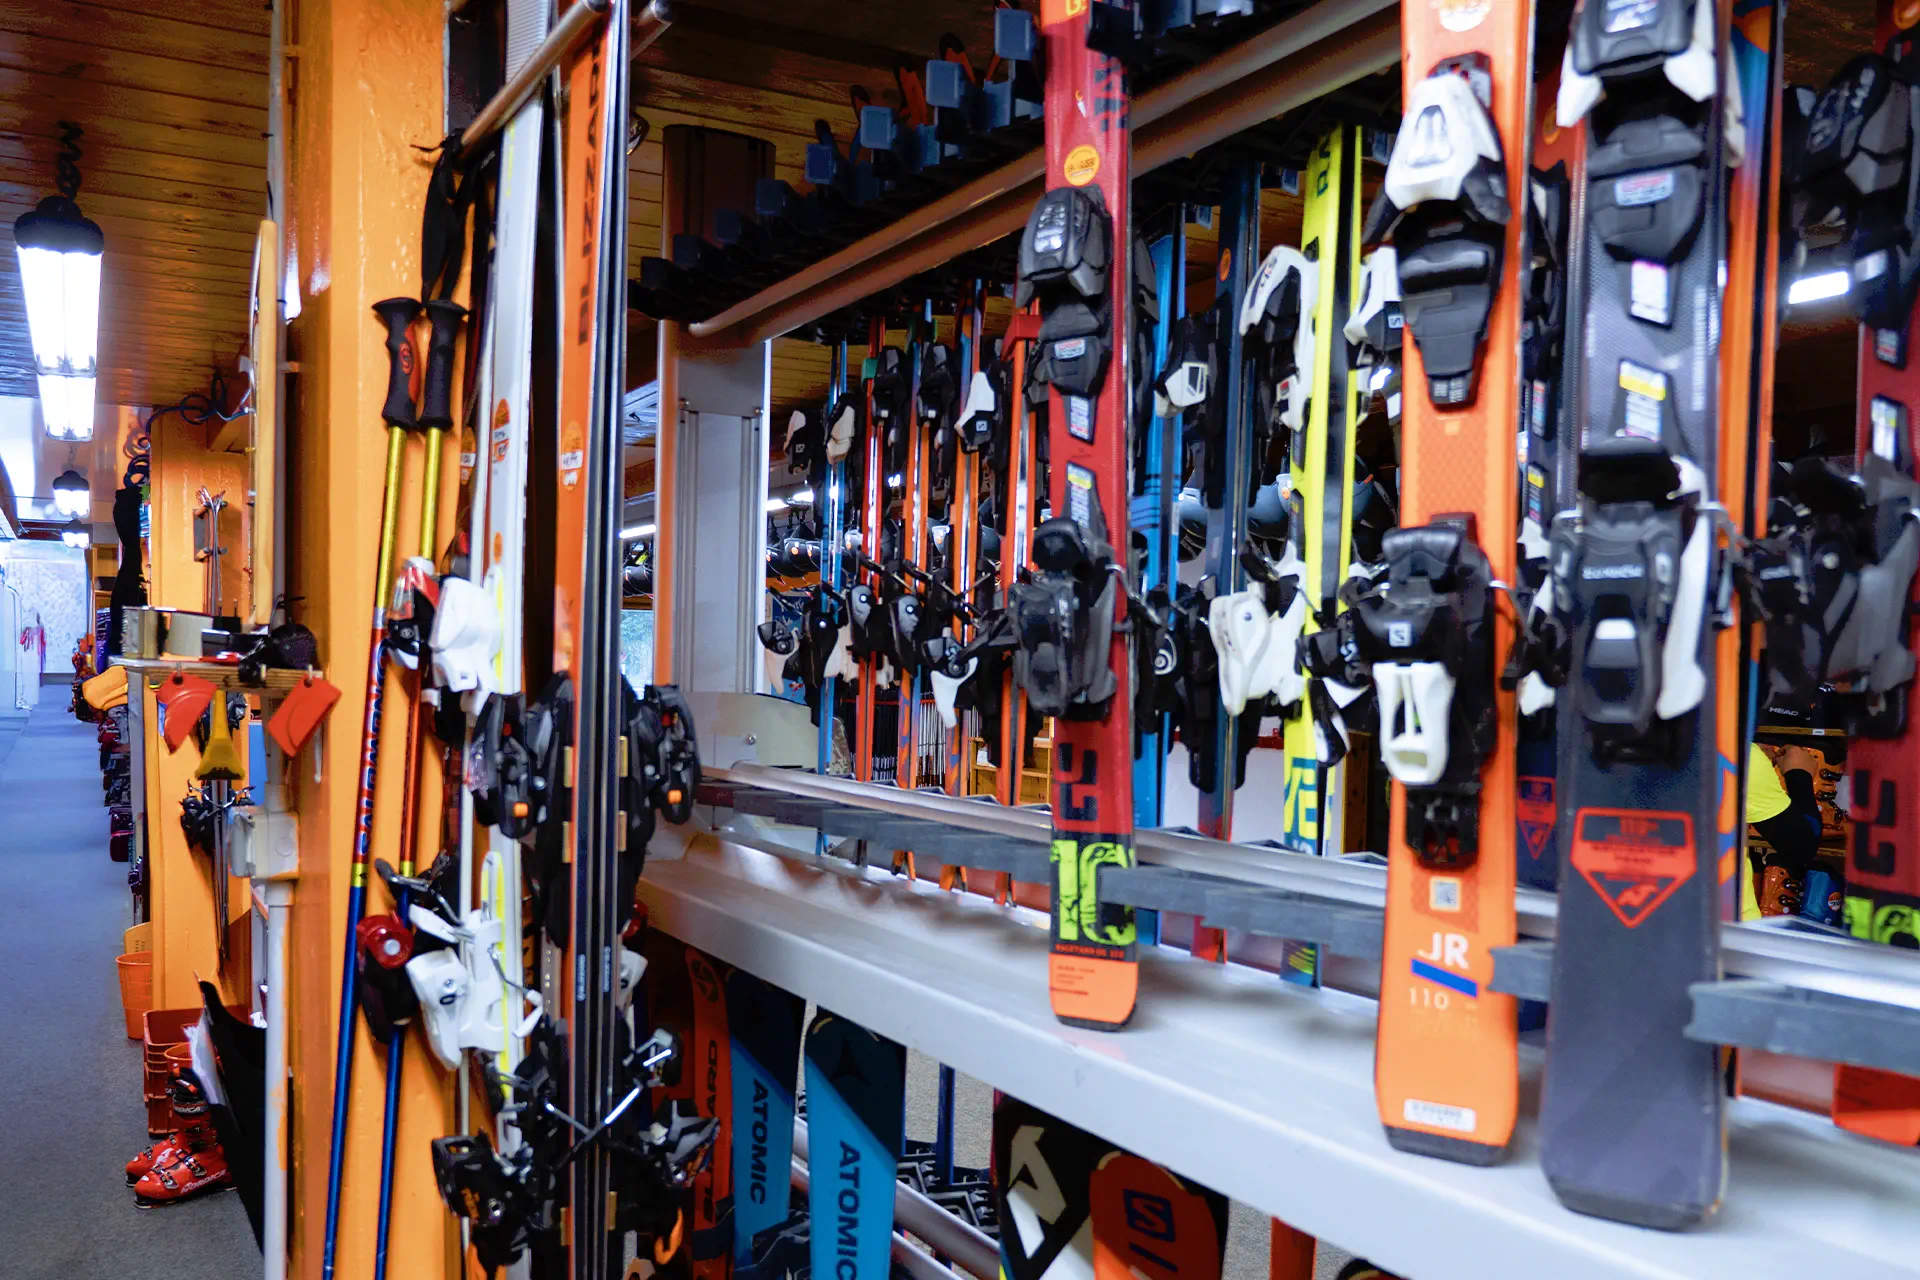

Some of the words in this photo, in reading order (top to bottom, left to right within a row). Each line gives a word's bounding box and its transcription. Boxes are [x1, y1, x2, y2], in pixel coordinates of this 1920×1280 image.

[1769, 706, 1799, 716] HEAD
[1417, 931, 1469, 969] JR
[1409, 986, 1449, 1011] 110
[751, 1078, 769, 1205] ATOMIC
[836, 1139, 861, 1280] ATOMIC
